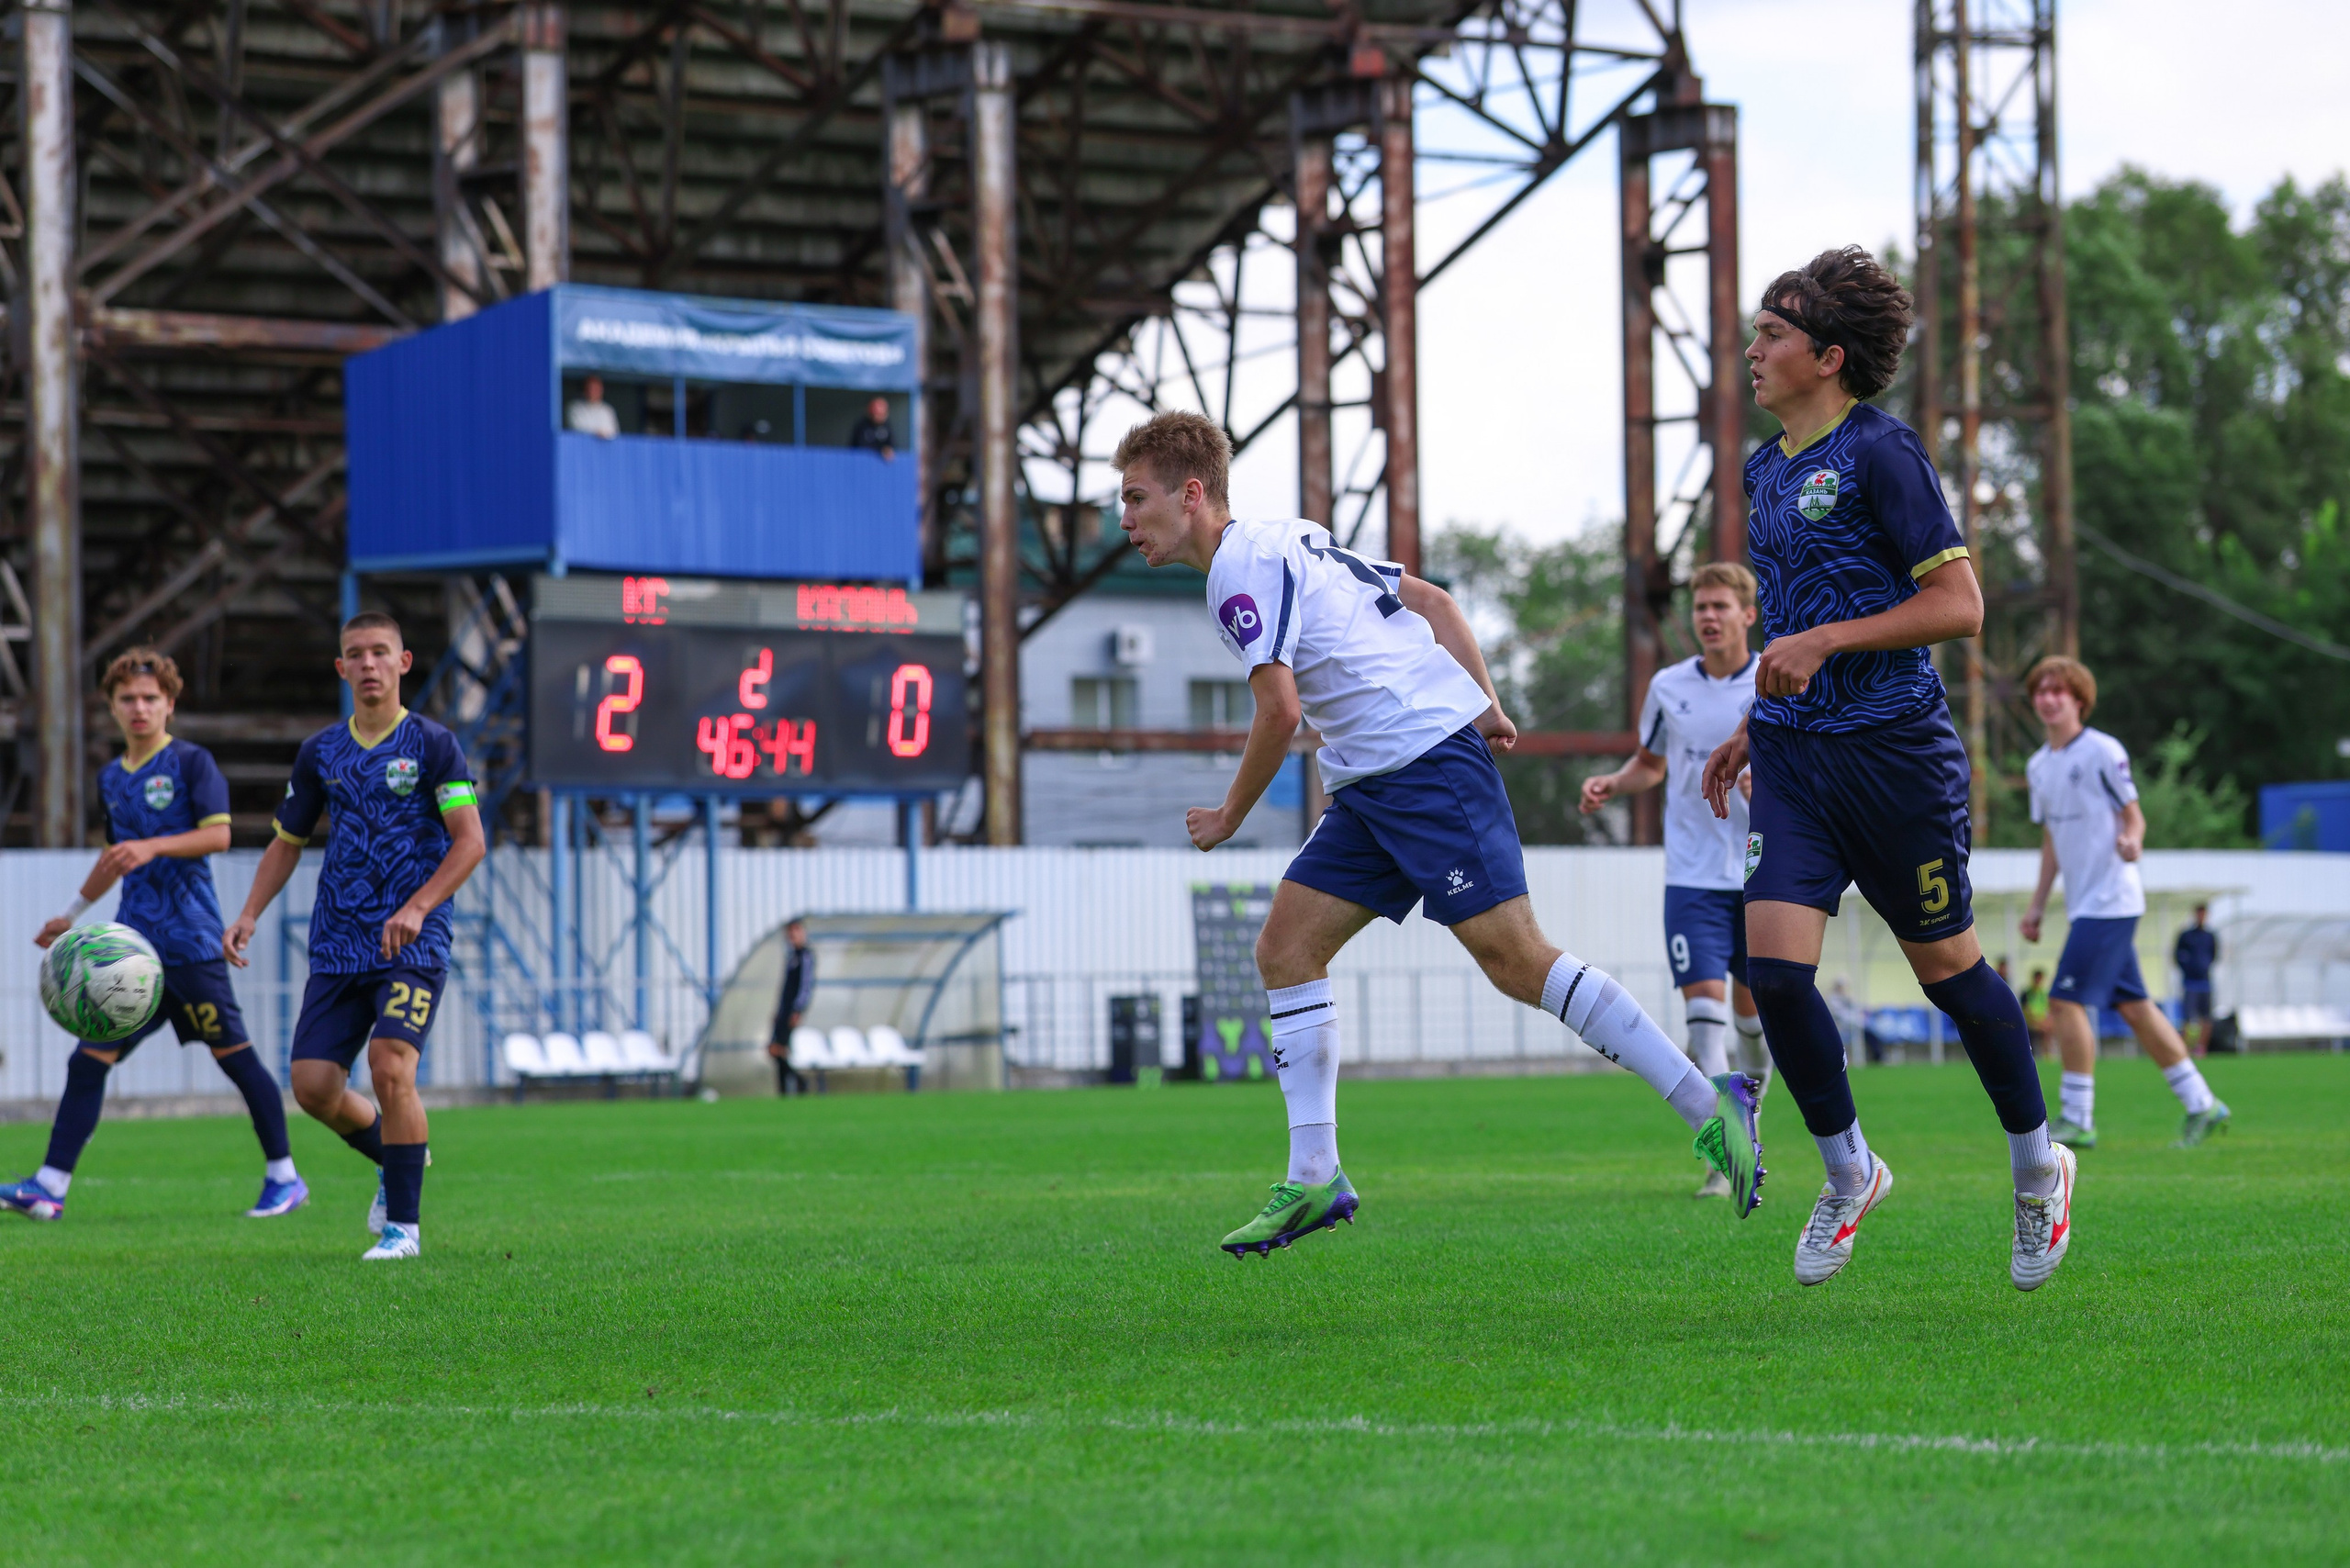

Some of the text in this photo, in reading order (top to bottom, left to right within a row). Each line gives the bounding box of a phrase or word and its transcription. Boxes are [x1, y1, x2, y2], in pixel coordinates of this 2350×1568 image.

[1227, 605, 1257, 639] wb
[596, 655, 644, 753] 2
[887, 664, 933, 757] 0
[1447, 880, 1474, 896] KELME
[1917, 857, 1950, 914] 5
[1930, 913, 1951, 924] SPORT
[1671, 933, 1691, 973] 9
[184, 1002, 222, 1033] 12
[383, 980, 432, 1026] 25
